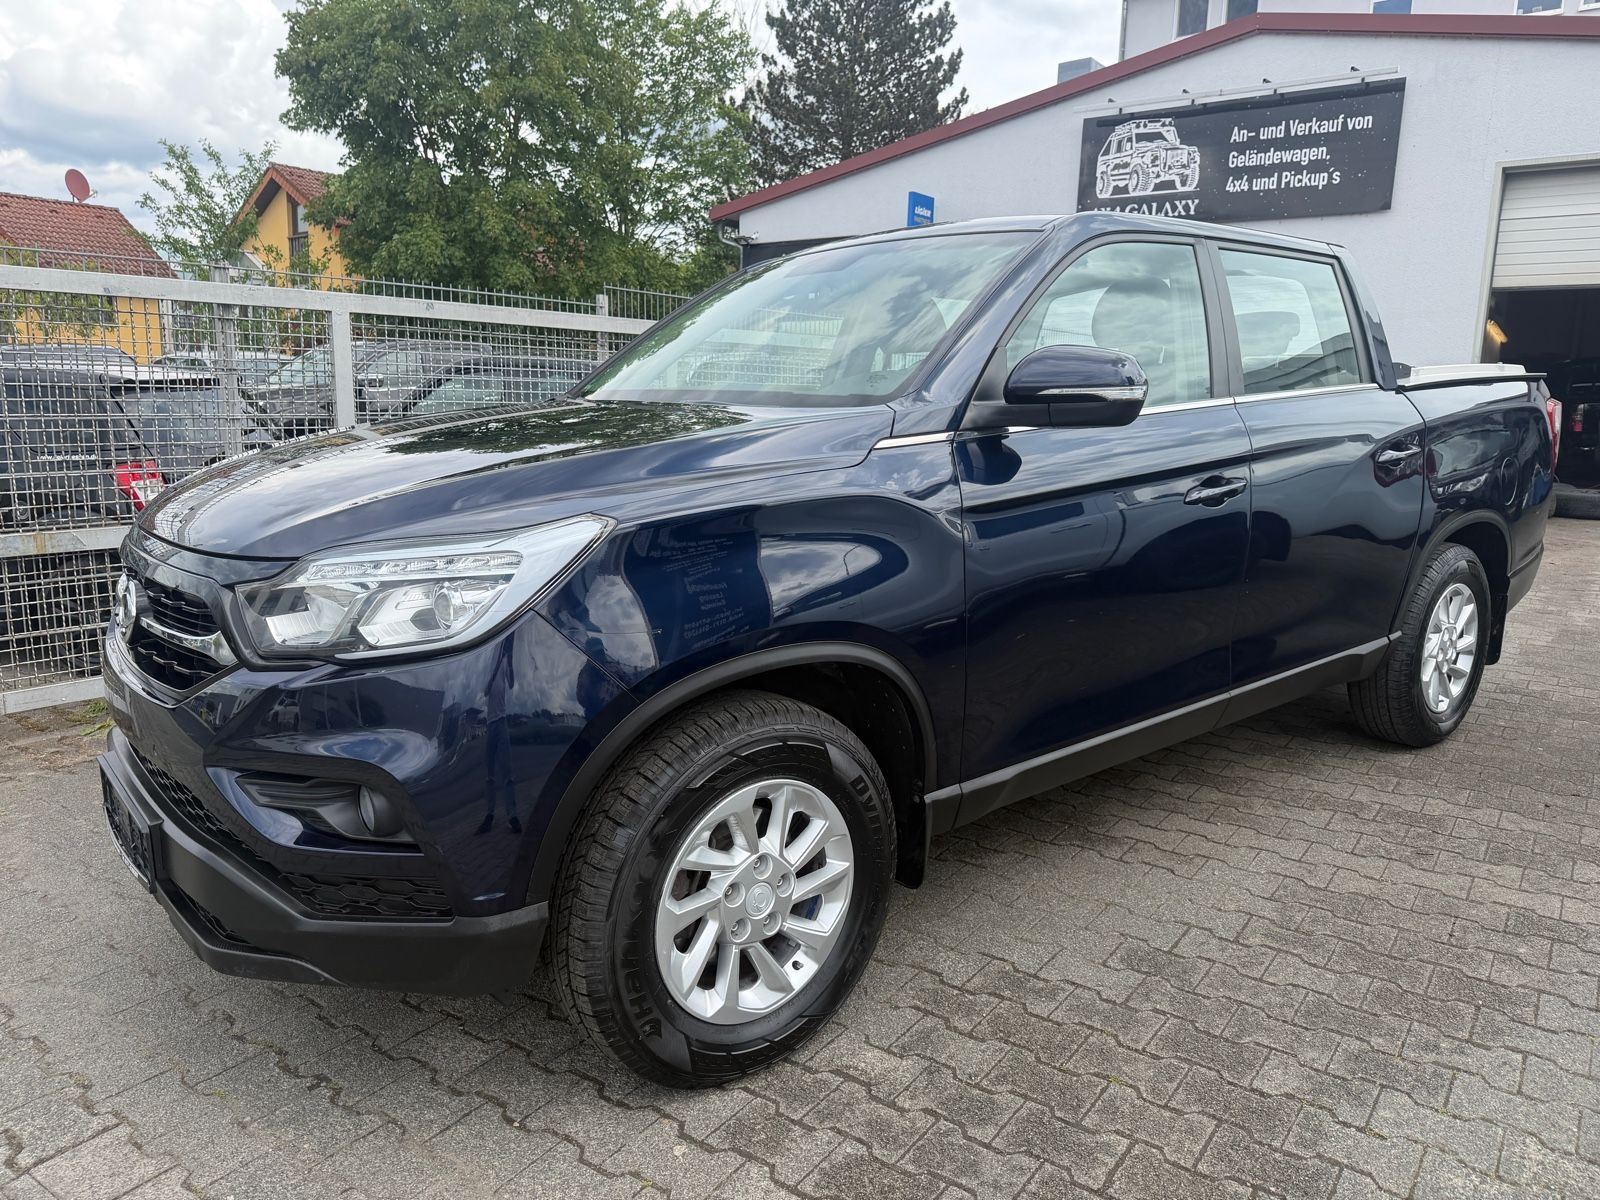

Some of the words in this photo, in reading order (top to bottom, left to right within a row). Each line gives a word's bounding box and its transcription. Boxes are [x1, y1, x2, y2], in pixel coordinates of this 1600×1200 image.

[1230, 126, 1256, 143] An-
[1259, 121, 1285, 139] und
[1289, 114, 1345, 137] Verkauf
[1347, 115, 1373, 131] von
[1228, 146, 1331, 168] Geländewagen,
[1225, 175, 1249, 193] 4x4
[1252, 173, 1278, 191] und
